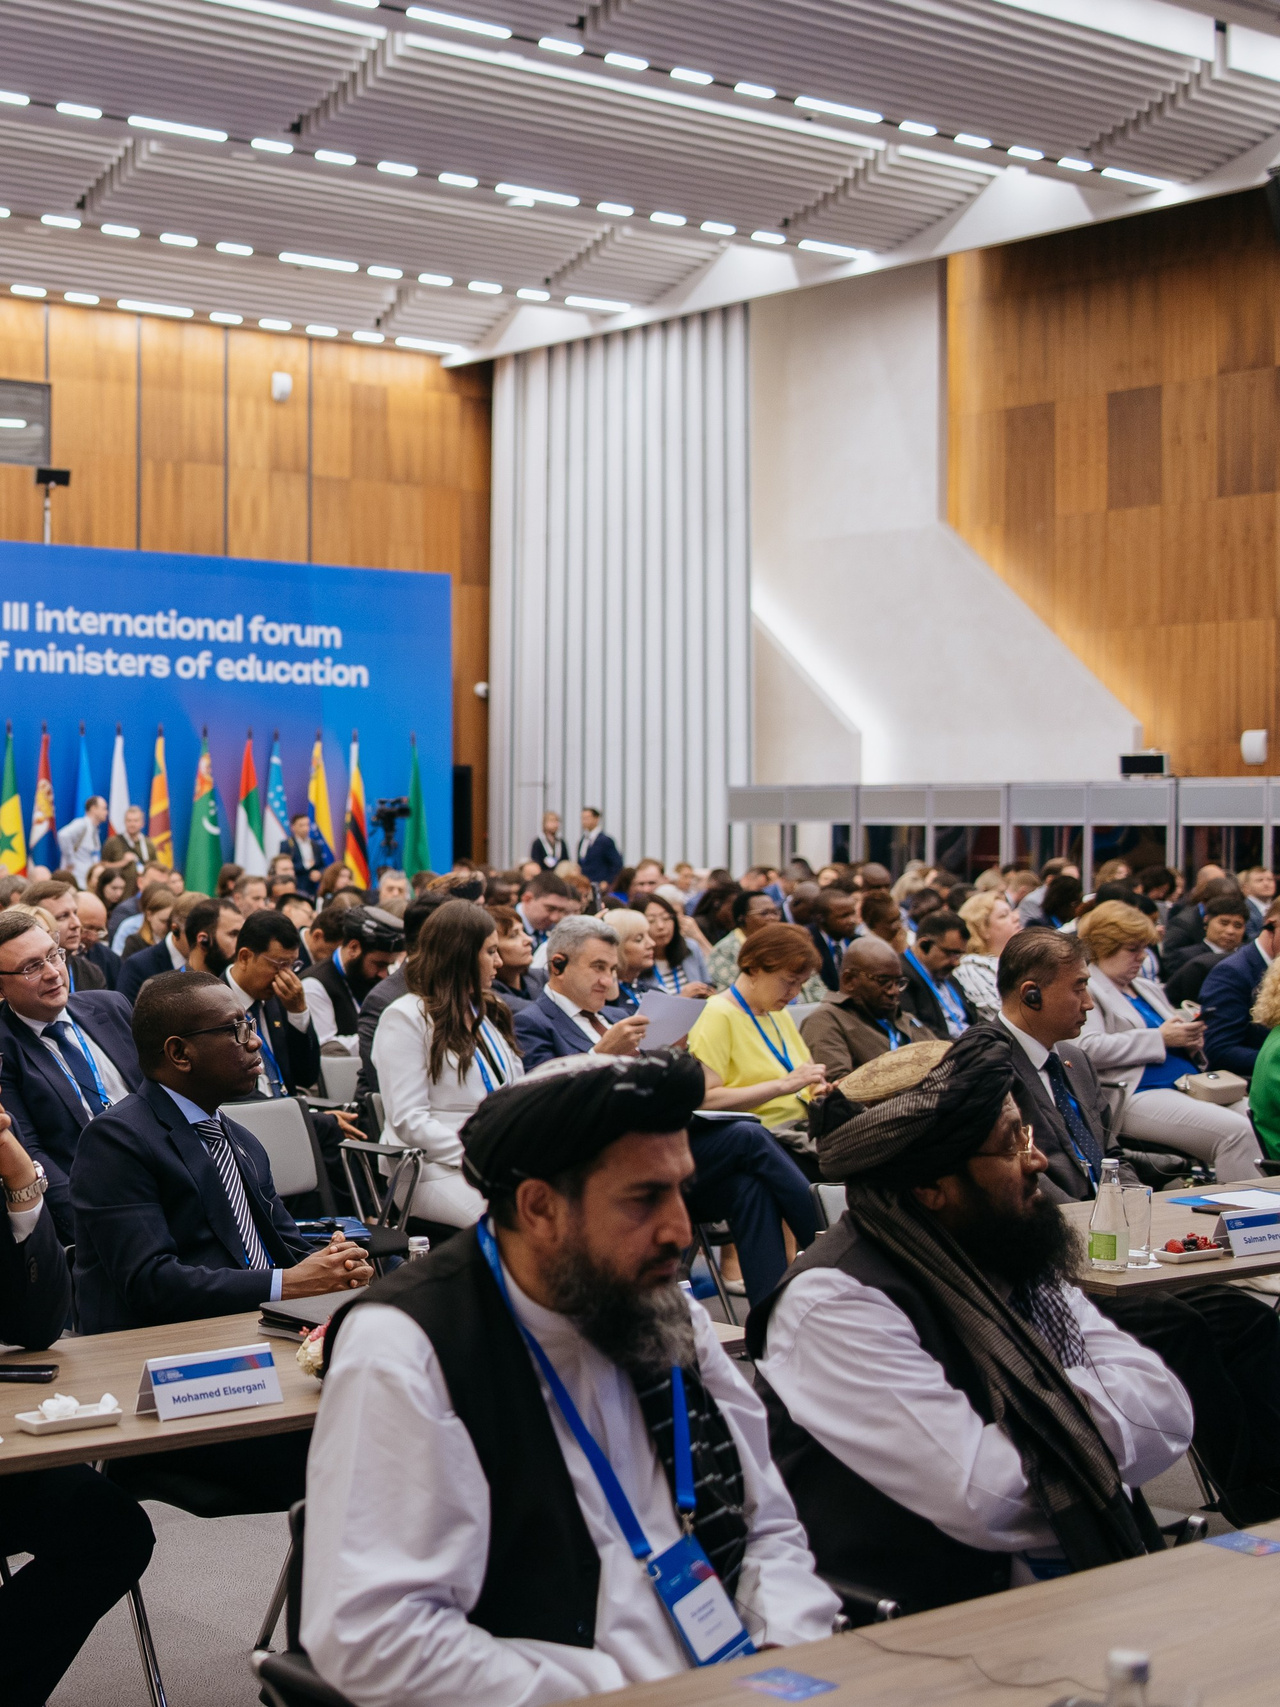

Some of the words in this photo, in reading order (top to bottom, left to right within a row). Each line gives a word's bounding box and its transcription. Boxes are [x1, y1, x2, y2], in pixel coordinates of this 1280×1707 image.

[3, 601, 29, 631] III
[36, 601, 243, 642] international
[248, 614, 342, 648] forum
[15, 642, 171, 678] ministers
[175, 650, 212, 682] of
[216, 653, 369, 689] education
[1243, 1235, 1267, 1244] Salman
[172, 1388, 221, 1404] Mohamed
[223, 1380, 266, 1396] Elsergani
